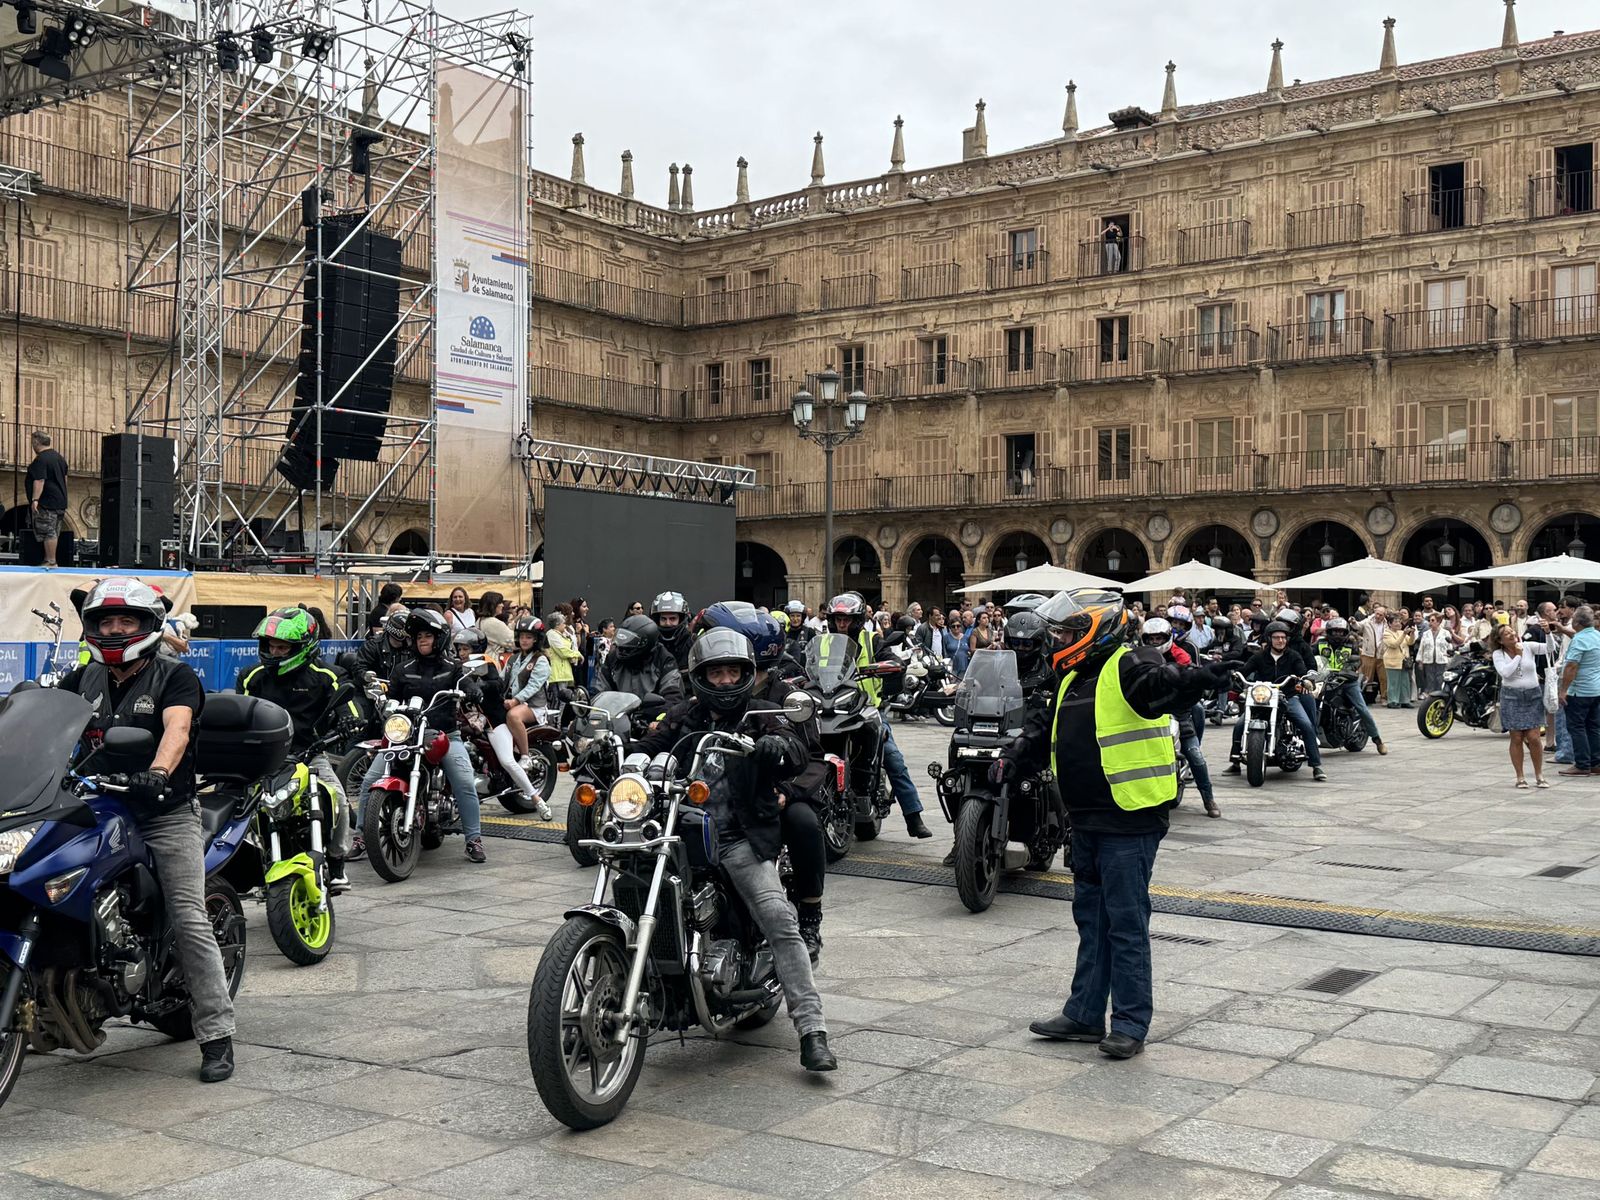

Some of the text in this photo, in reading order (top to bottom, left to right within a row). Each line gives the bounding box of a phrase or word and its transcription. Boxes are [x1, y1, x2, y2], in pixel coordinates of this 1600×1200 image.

[472, 272, 513, 291] Ayuntamiento
[472, 284, 514, 302] de Salamanca
[461, 335, 502, 353] Salamanca
[450, 356, 482, 368] AYUNTAMIENTO
[490, 363, 513, 373] SALAMANCA
[231, 647, 259, 656] POLICI
